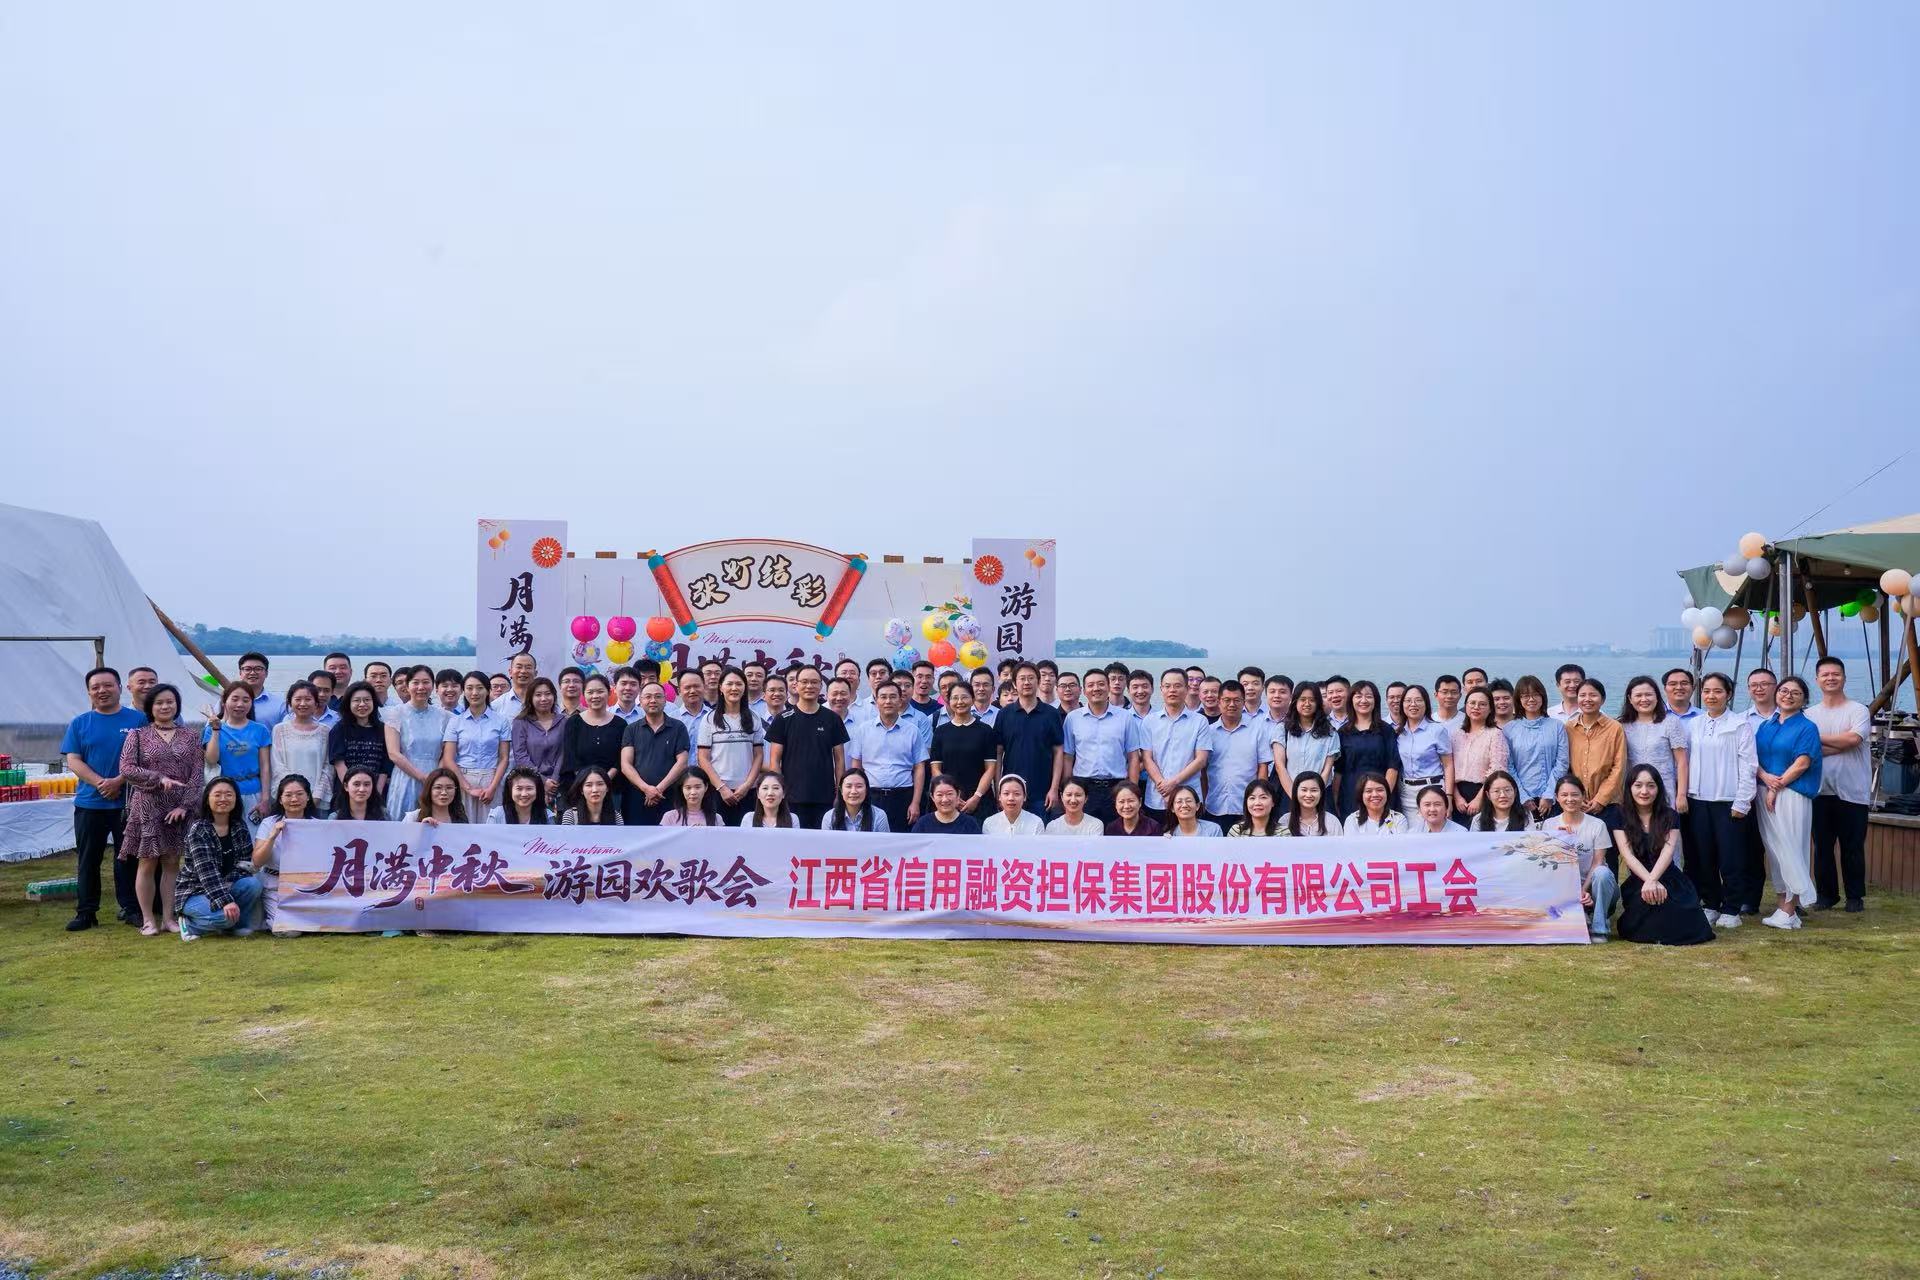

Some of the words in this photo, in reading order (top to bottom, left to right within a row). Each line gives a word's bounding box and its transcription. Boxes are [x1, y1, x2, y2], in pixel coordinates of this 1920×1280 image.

[688, 554, 826, 609] 张灯结彩
[488, 571, 534, 663] 月满
[997, 582, 1038, 663] 游园
[296, 838, 535, 914] 月满中秋
[543, 855, 774, 908] 游园欢歌会
[523, 837, 624, 856] Mid-autumn
[788, 855, 1479, 915] 江西省信用融资担保集团股份有限公司工会
